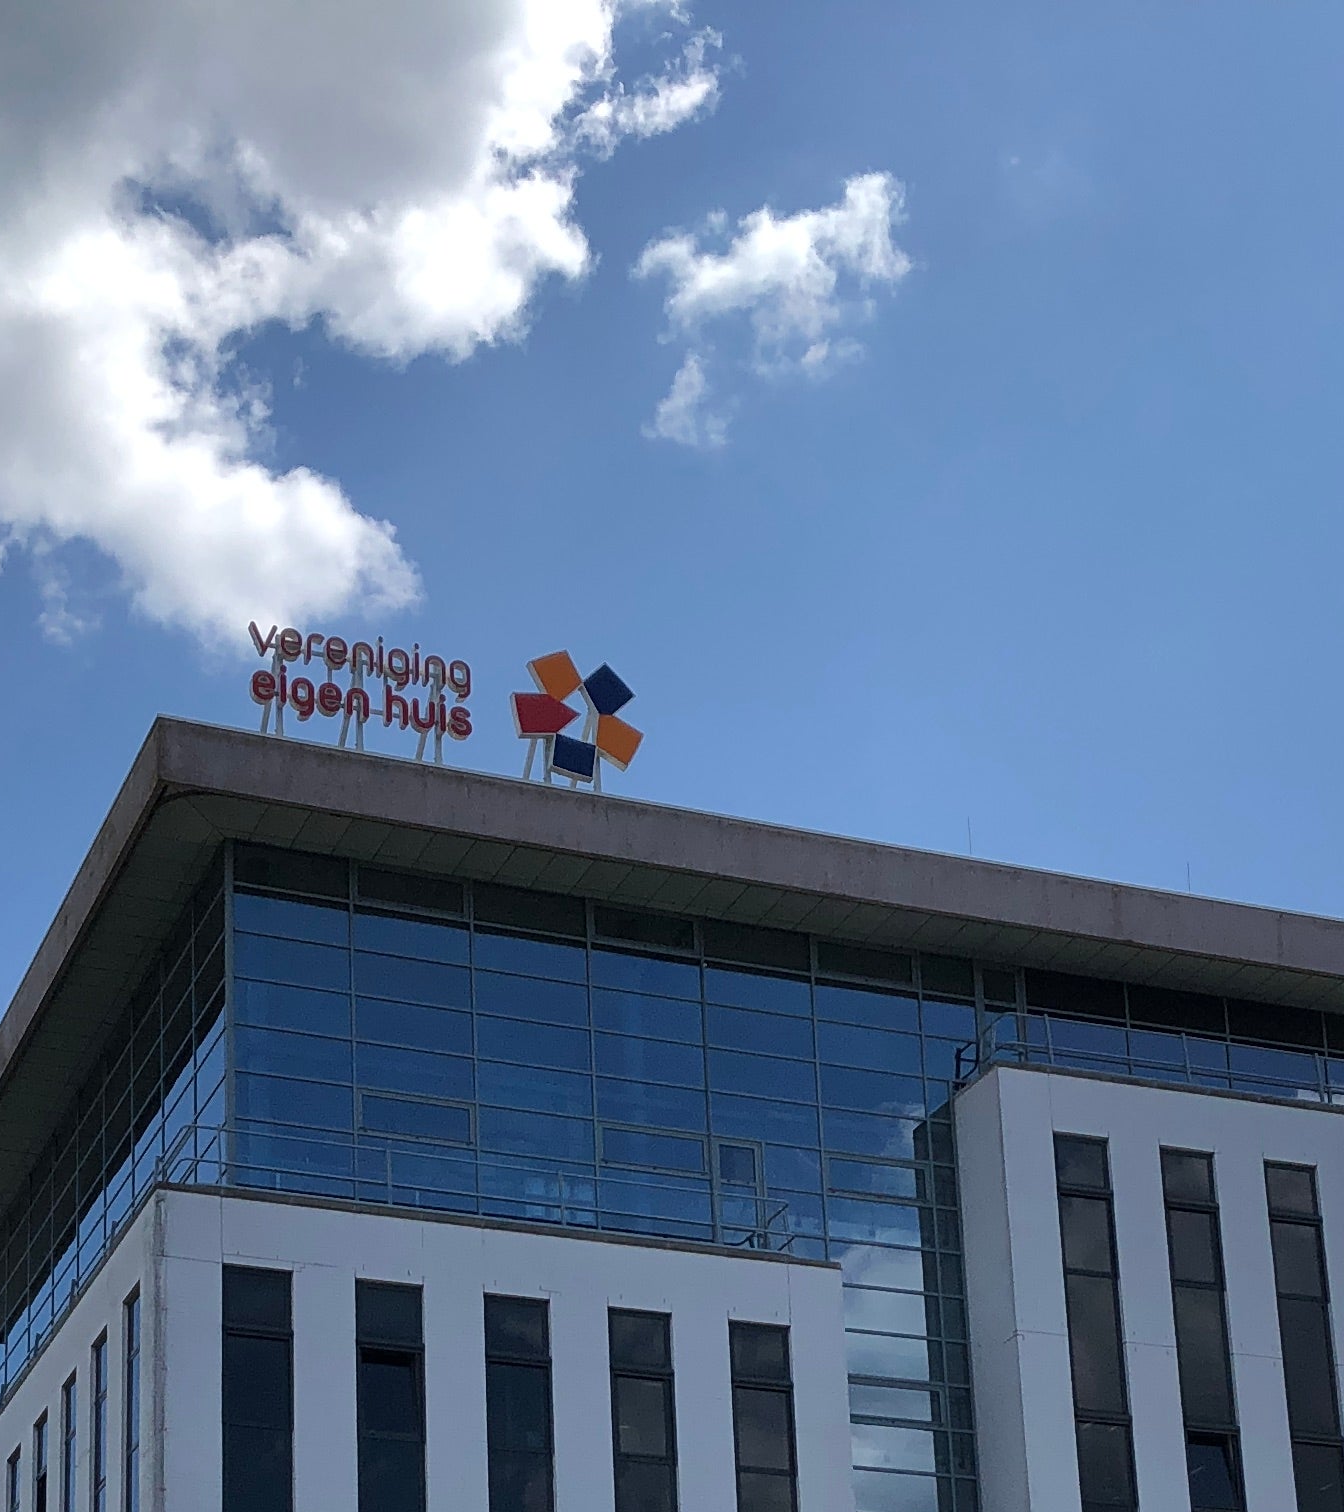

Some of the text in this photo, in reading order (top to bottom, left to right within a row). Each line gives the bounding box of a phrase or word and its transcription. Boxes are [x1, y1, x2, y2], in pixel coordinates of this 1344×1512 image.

[248, 621, 471, 702] vereniging
[250, 664, 473, 740] eigen huis
